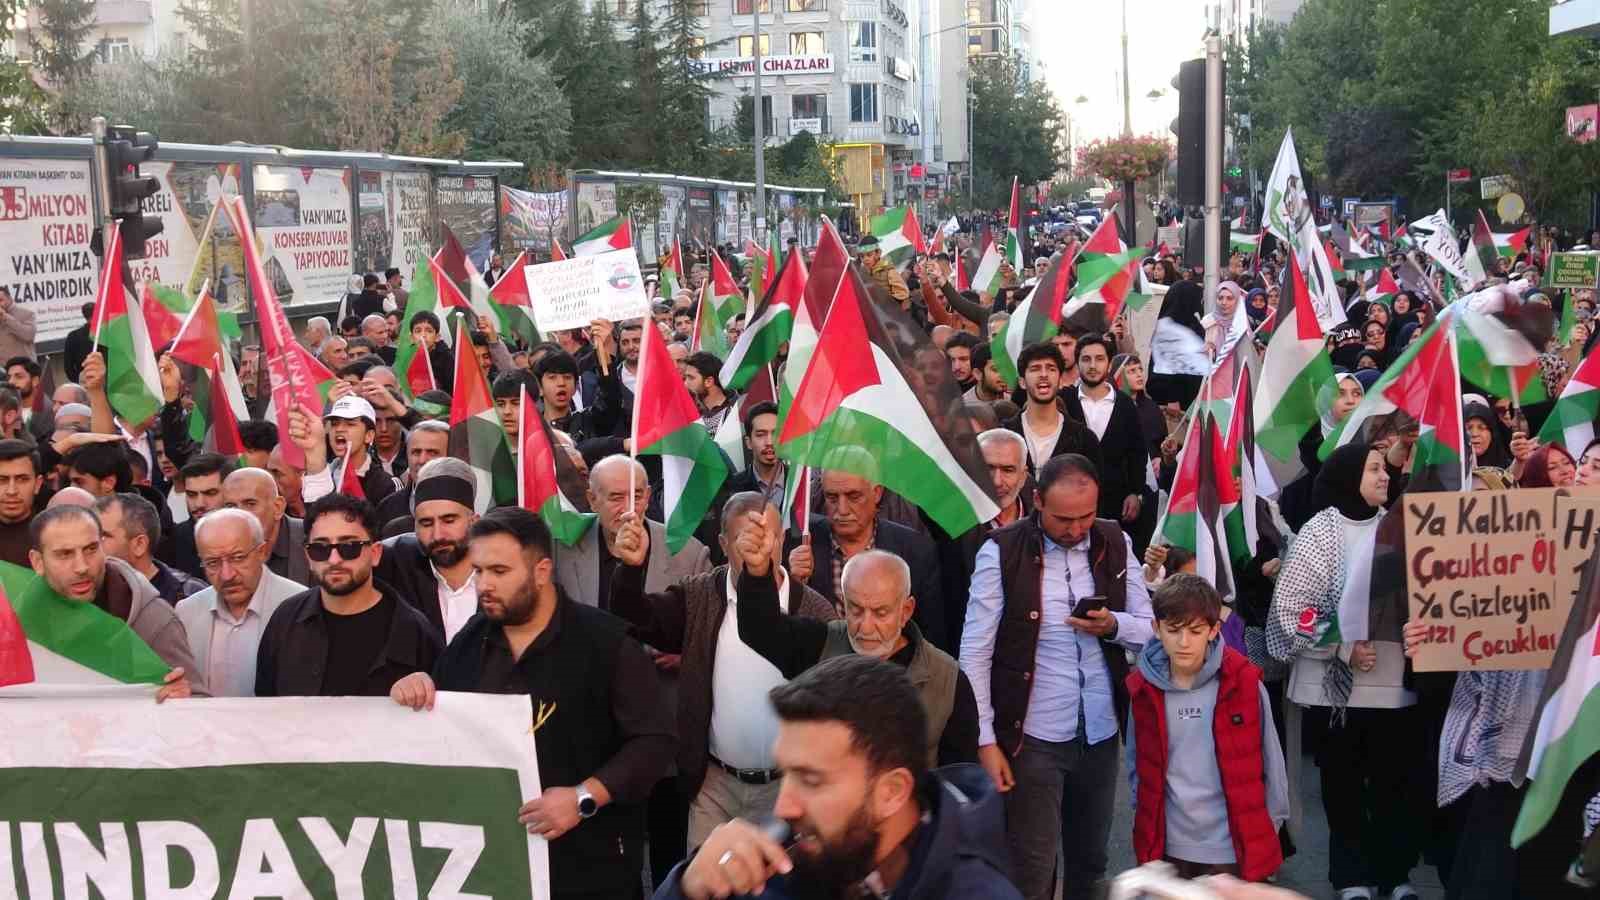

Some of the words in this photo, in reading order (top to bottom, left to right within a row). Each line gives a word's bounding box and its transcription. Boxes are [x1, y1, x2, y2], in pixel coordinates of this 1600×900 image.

[763, 57, 829, 72] CİHAZLARI
[302, 209, 347, 225] VAN'IMIZA
[274, 231, 348, 249] KONSERVATUVAR
[12, 251, 92, 275] VAN'IMIZA
[294, 249, 349, 269] YAPIYORUZ
[4, 278, 93, 303] ZANDIRDIK
[1409, 501, 1446, 536] Ya
[1456, 493, 1541, 535] Kalkın
[1412, 542, 1524, 588] Çocuklar
[1413, 591, 1443, 619] Ya
[1449, 584, 1551, 624] Gizleyin
